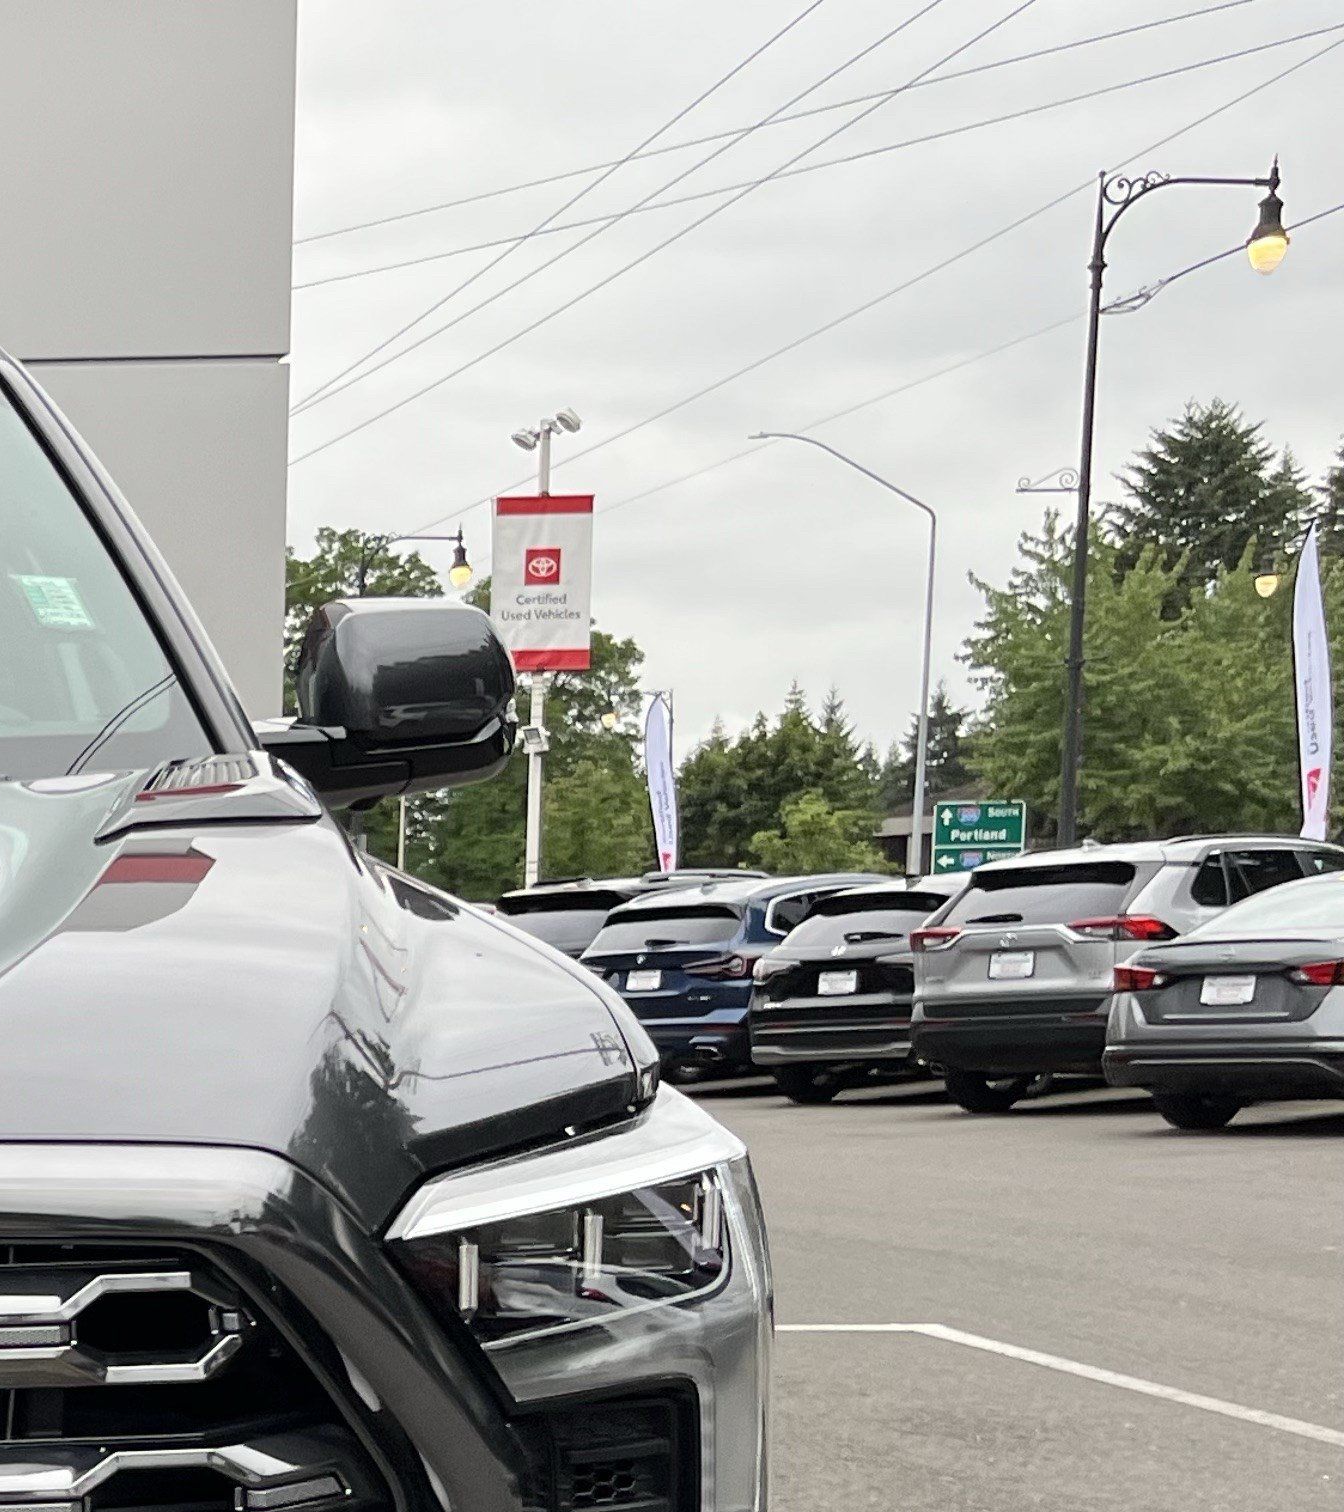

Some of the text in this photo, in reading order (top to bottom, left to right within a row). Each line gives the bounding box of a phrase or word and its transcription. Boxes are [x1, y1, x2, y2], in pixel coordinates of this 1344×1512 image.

[515, 593, 568, 606] Certified
[501, 609, 582, 621] Used Vehicles
[950, 828, 1007, 842] Portland
